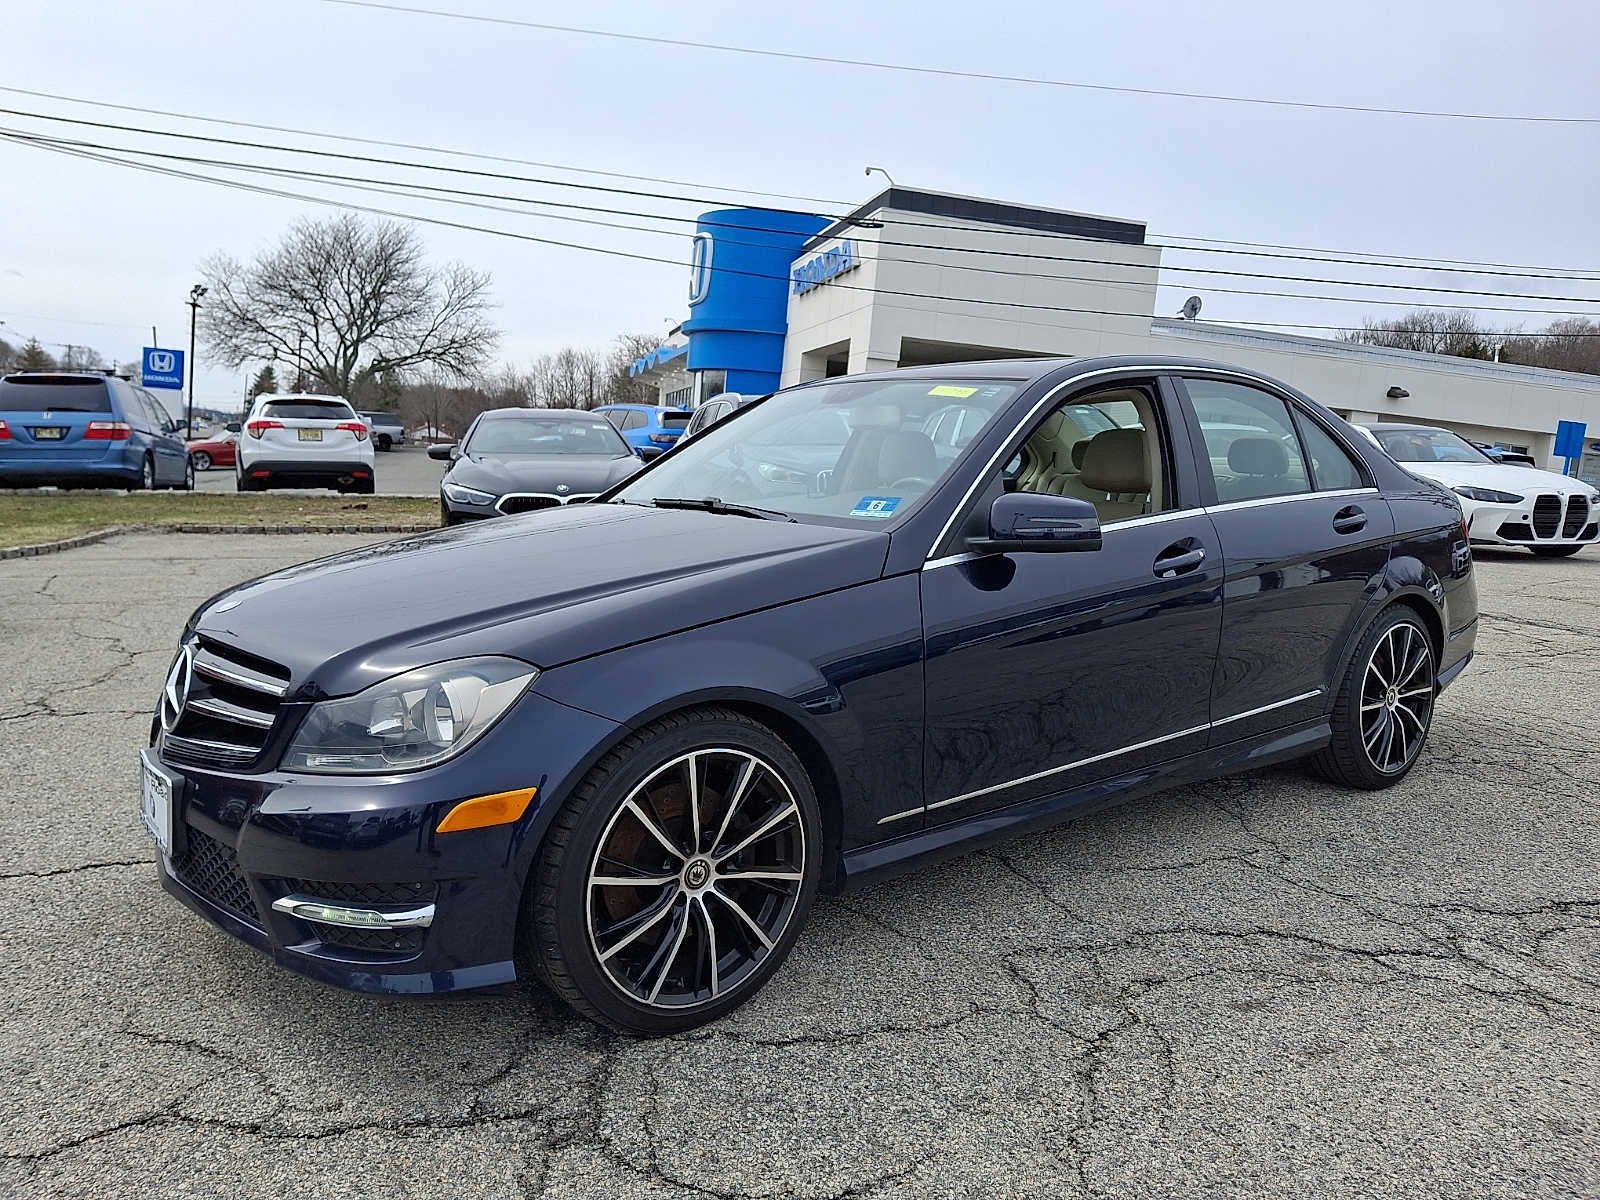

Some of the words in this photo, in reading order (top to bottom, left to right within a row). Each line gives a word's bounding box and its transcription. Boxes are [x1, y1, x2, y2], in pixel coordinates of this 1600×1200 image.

[793, 241, 852, 295] HONDA
[143, 374, 180, 383] HONDA
[872, 502, 882, 510] 6
